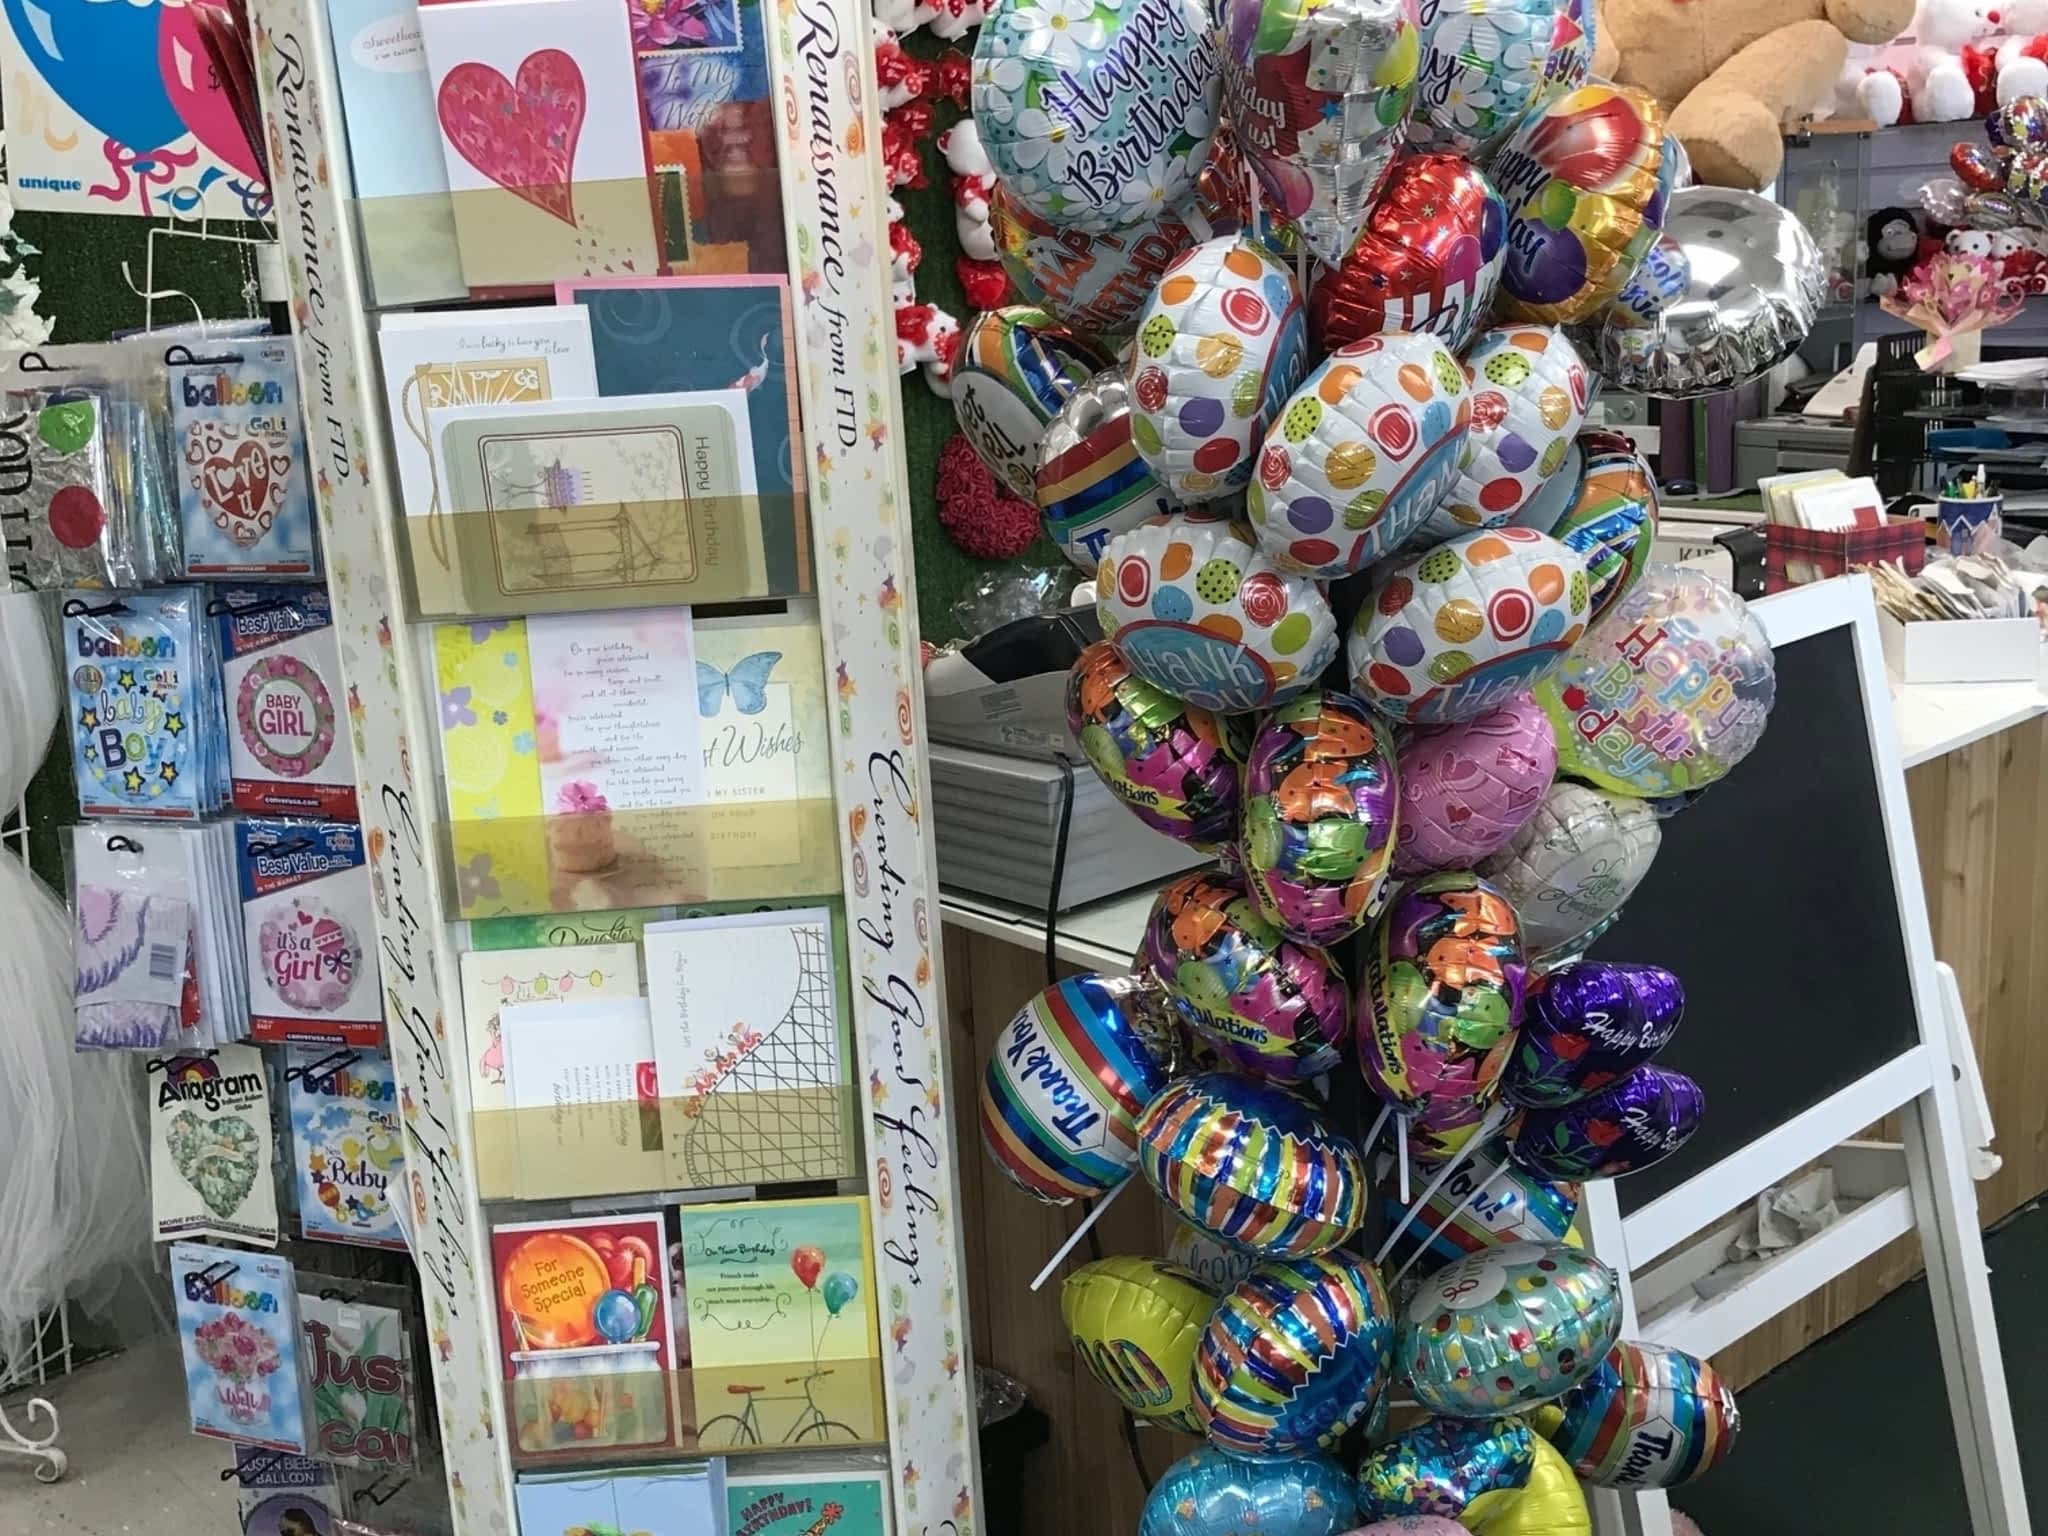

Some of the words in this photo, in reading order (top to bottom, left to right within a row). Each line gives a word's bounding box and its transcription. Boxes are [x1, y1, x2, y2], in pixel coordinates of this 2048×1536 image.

[689, 58, 735, 104] My
[1040, 0, 1188, 140] Happy
[796, 1, 841, 297] Renaissance
[19, 175, 82, 192] unique
[268, 27, 324, 328] Renaissance
[305, 328, 335, 407] from
[326, 415, 351, 480] FTD
[816, 296, 848, 386] from
[183, 372, 284, 408] balloon
[832, 386, 858, 449] FTD
[696, 436, 712, 491] Happy
[703, 494, 721, 567] Birthday
[236, 612, 271, 635] Best
[268, 608, 305, 632] Value
[77, 625, 177, 658] balloon
[101, 689, 163, 733] baby
[266, 693, 301, 710] BABY
[259, 708, 313, 738] GIRL
[722, 721, 806, 768] Wishes
[732, 785, 765, 796] SISTER
[257, 855, 291, 876] Best
[289, 852, 329, 874] Value
[276, 931, 297, 951] it's
[300, 937, 311, 951] a
[274, 951, 323, 989] Girl
[1581, 1011, 1638, 1057] Happy
[158, 1072, 264, 1112] Anagram
[1022, 1045, 1101, 1148] Thank
[1620, 1106, 1664, 1152] Happy
[328, 1157, 388, 1201] Baby
[159, 1217, 183, 1227] MORE
[534, 1257, 558, 1277] For
[705, 1247, 718, 1257] On
[718, 1244, 738, 1256] Your
[737, 1243, 776, 1257] Birthday
[521, 1265, 585, 1299] Someone
[532, 1283, 587, 1314] Special
[256, 1472, 315, 1485] BALLOON
[740, 1492, 785, 1522] HAPPY
